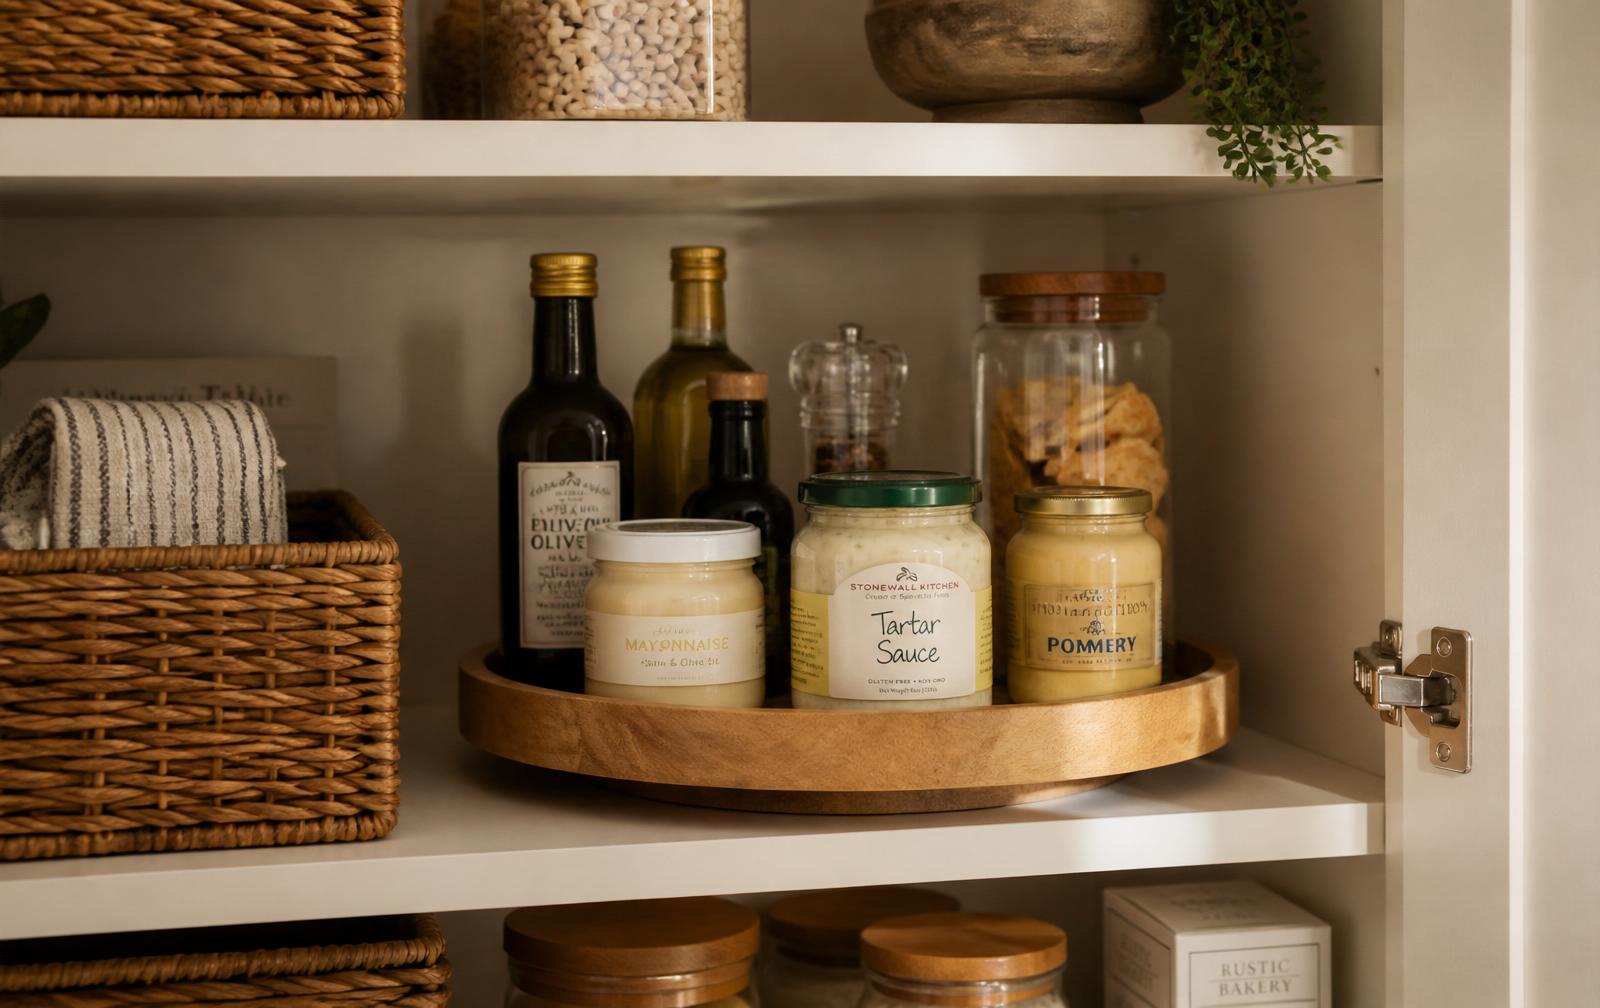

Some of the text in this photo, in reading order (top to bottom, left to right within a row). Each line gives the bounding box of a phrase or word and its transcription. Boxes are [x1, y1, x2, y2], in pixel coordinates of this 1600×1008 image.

[531, 534, 585, 550] OLIVE
[850, 581, 959, 592] STONEWALL KITCHEN
[870, 610, 941, 635] Tartar
[624, 636, 729, 652] MAYONNAISE
[876, 639, 940, 665] Sauce
[1047, 636, 1137, 654] POMMERY
[1221, 958, 1292, 978] RUSTIC
[1219, 978, 1293, 997] BAKERY
